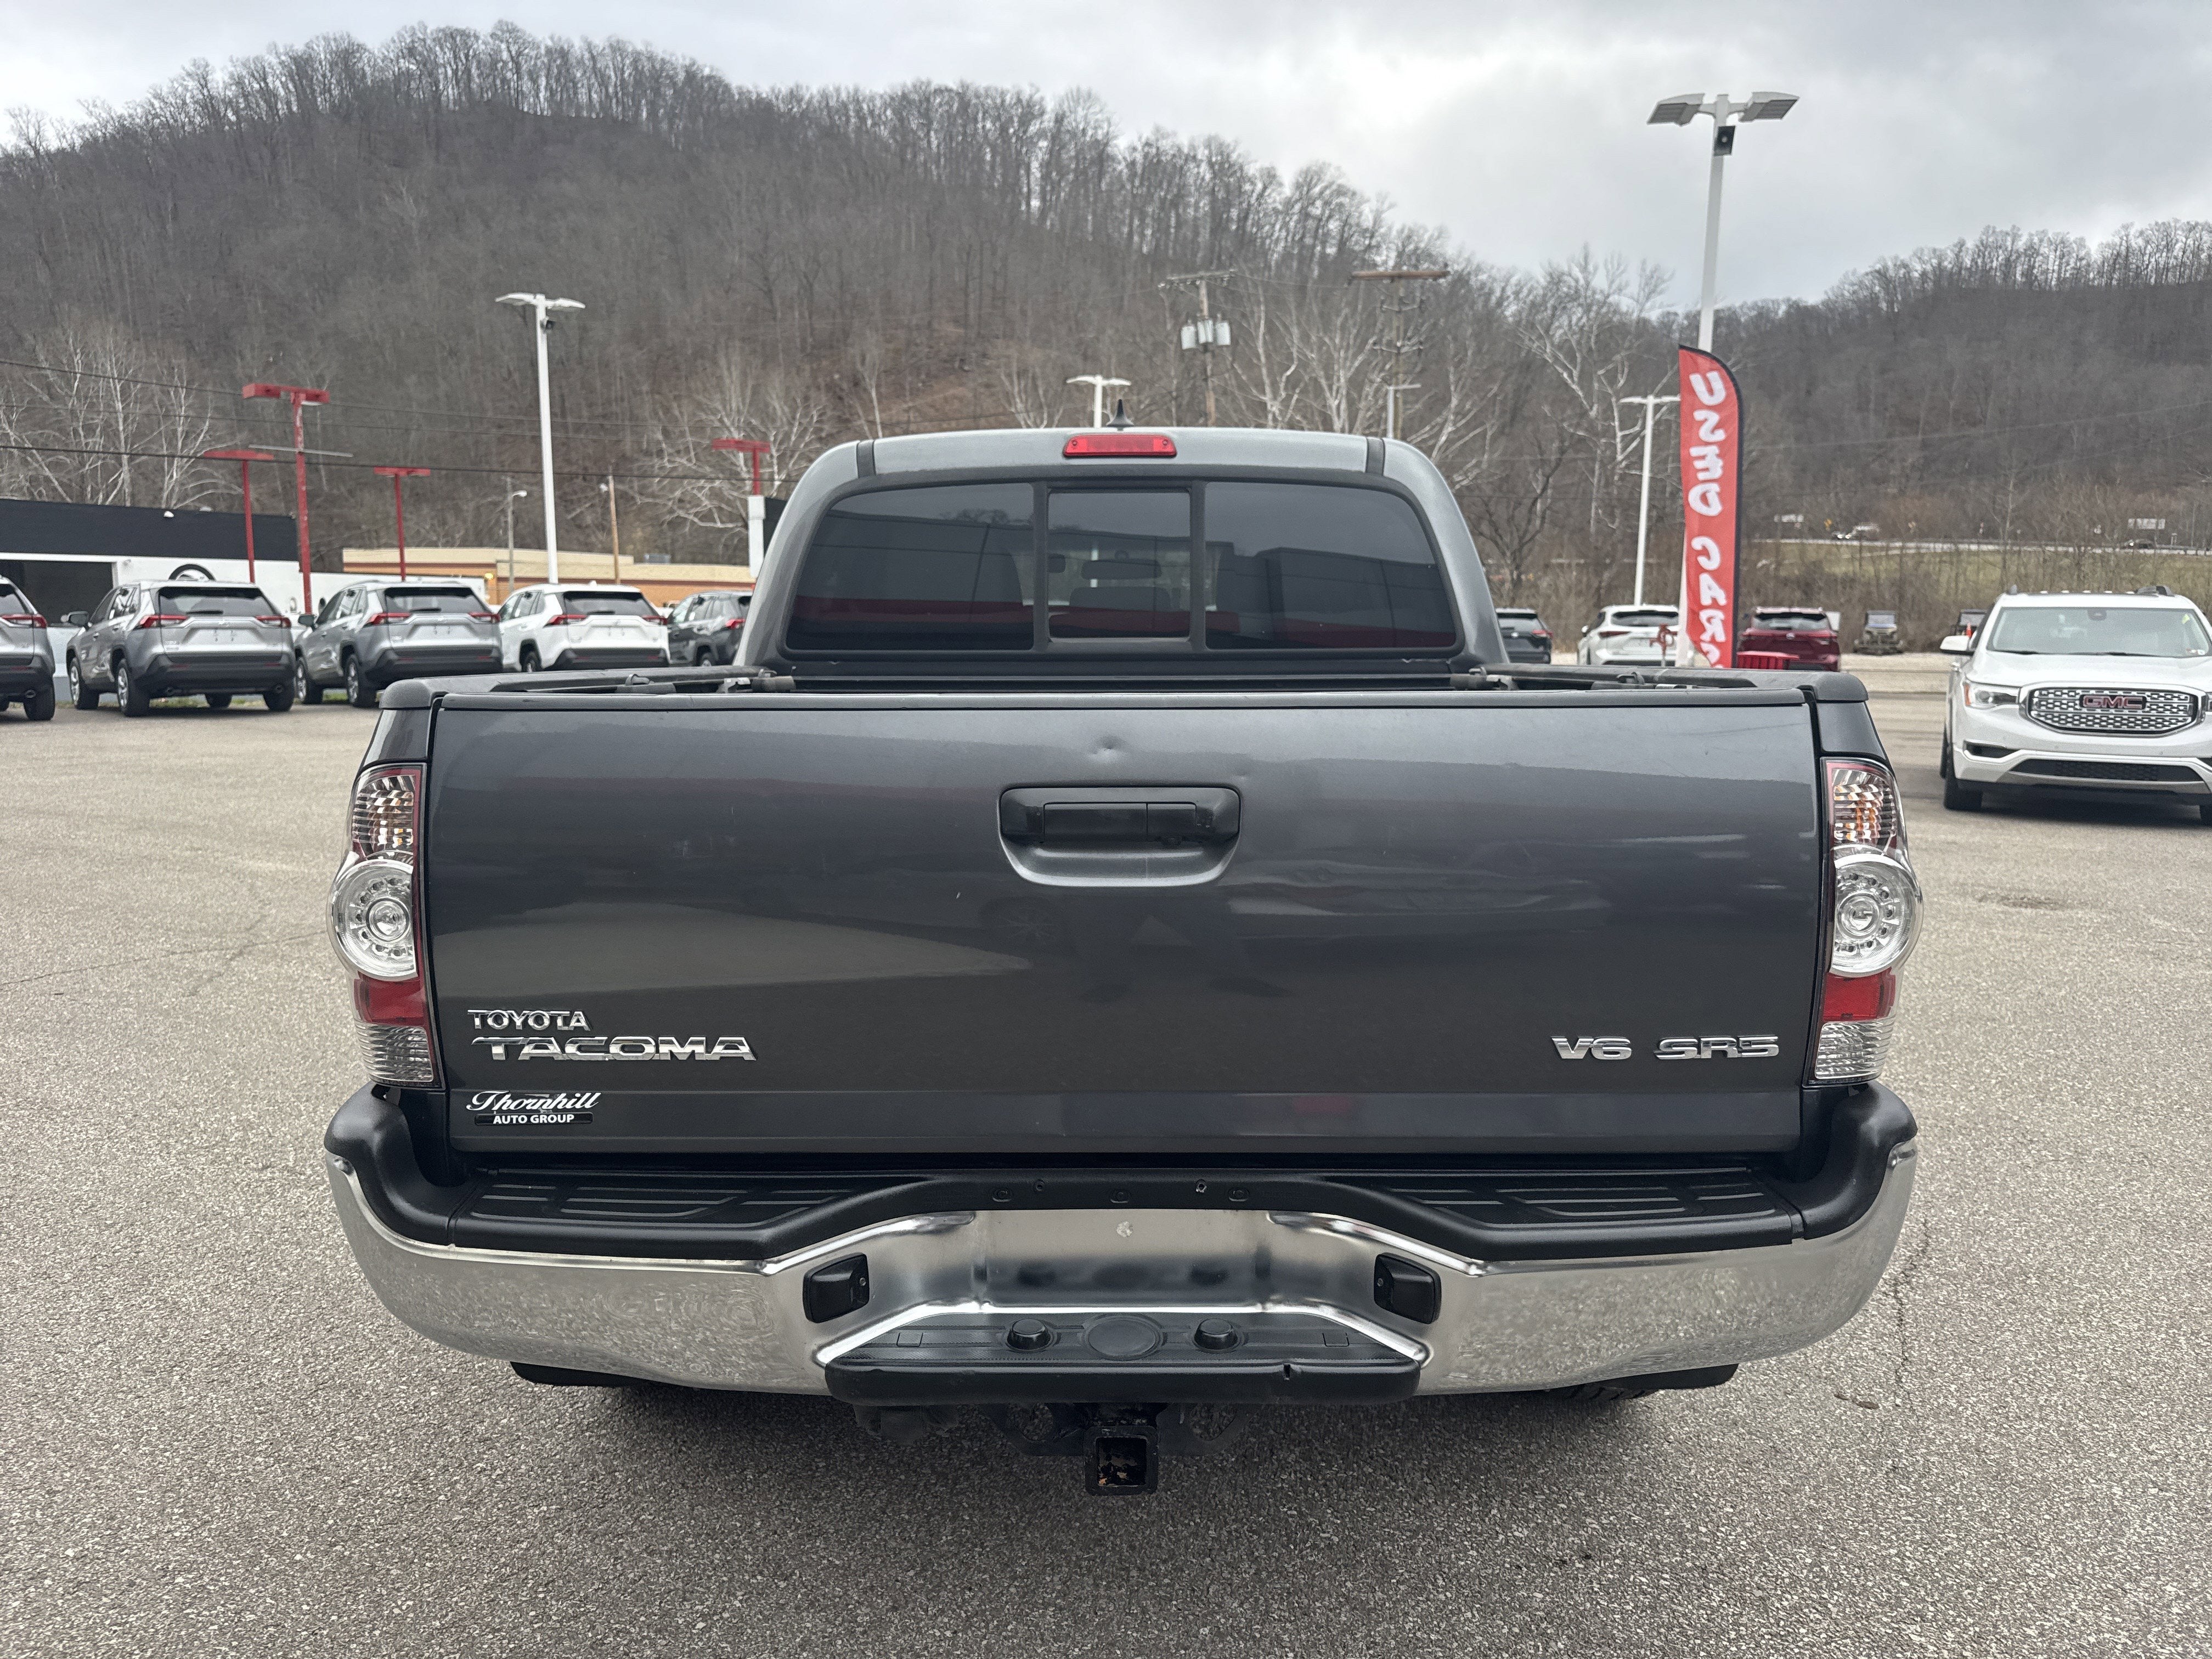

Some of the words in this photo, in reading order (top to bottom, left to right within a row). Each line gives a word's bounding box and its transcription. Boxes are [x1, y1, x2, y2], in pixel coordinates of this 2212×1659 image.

[2083, 695, 2143, 709] GMC
[467, 1009, 591, 1031] TOYOTA
[471, 1036, 757, 1061] TACOMA
[1551, 1036, 1632, 1060] V6
[1654, 1035, 1779, 1060] SR5
[466, 1090, 602, 1111] Thornhill
[493, 1115, 528, 1124] AUTO
[530, 1114, 575, 1124] GROUP
